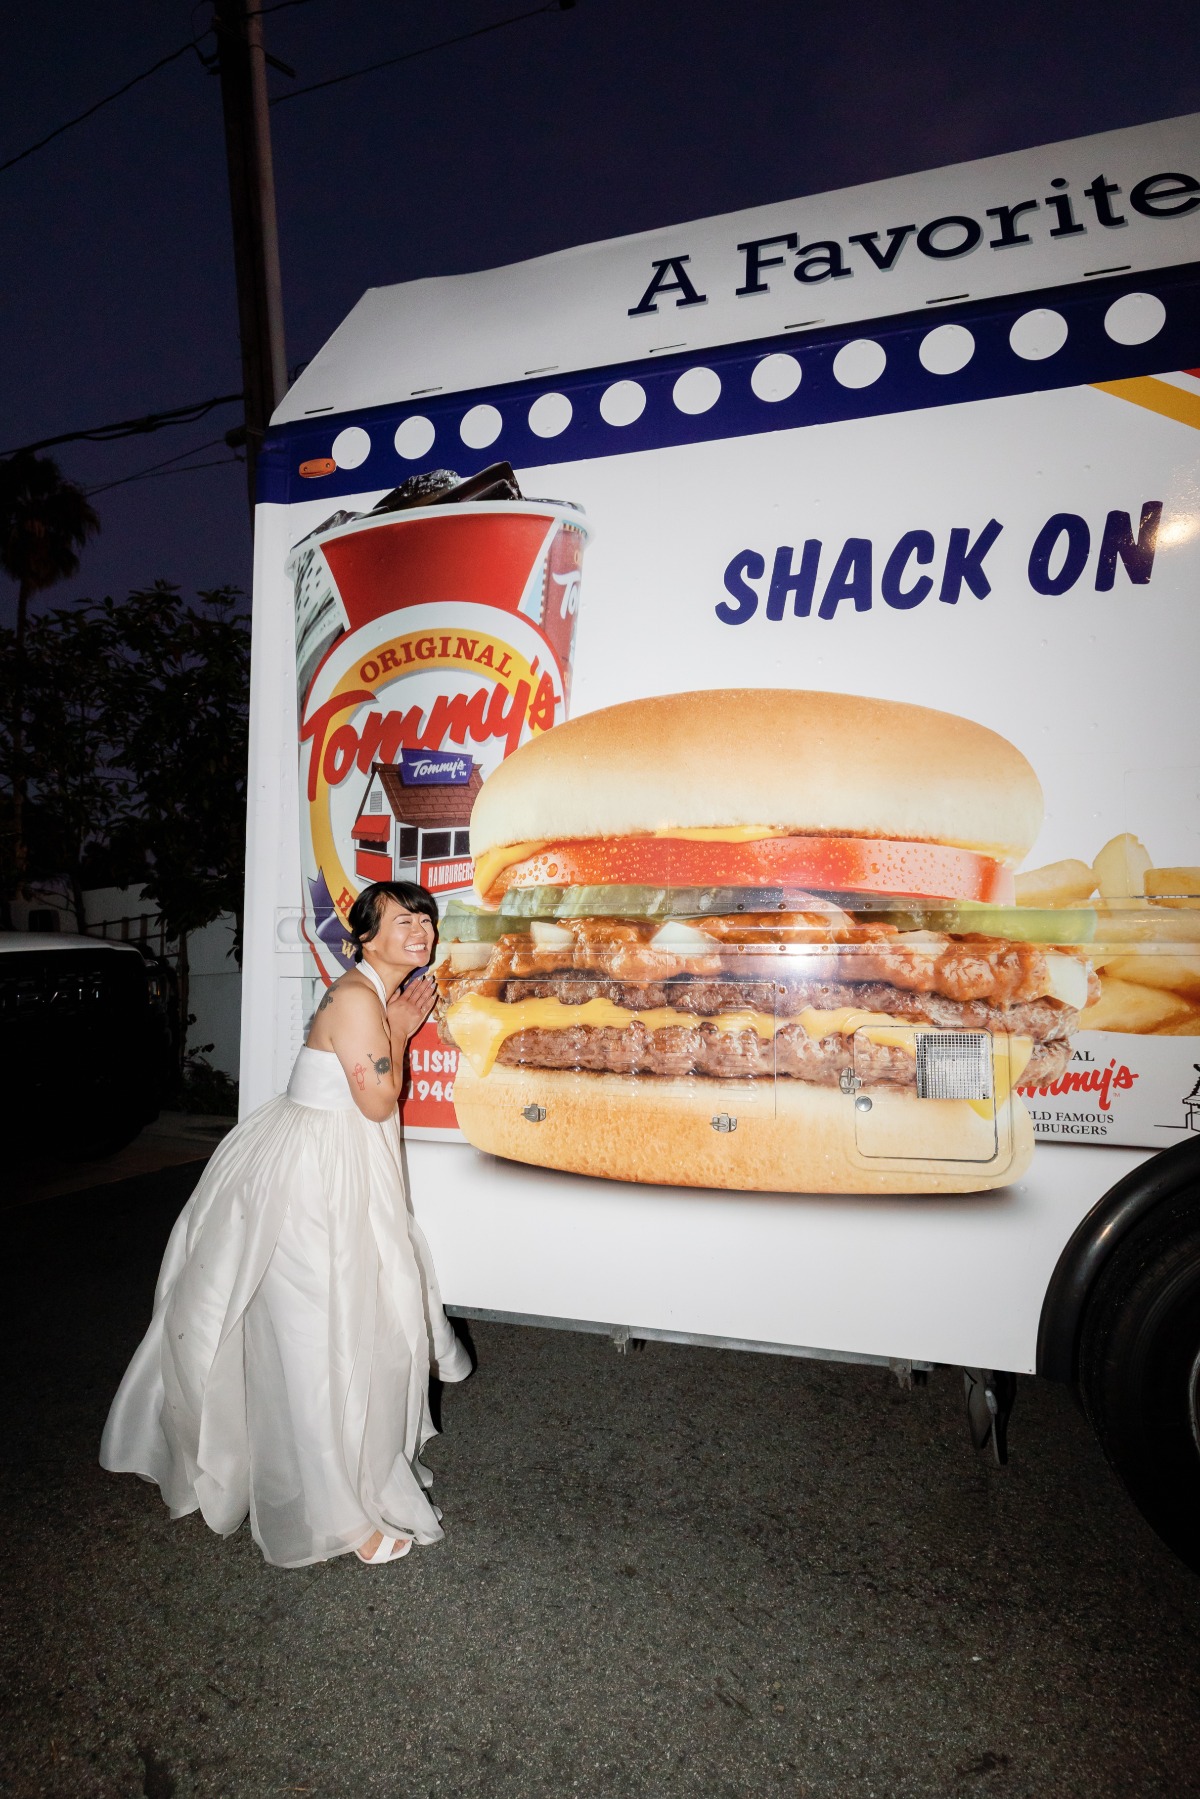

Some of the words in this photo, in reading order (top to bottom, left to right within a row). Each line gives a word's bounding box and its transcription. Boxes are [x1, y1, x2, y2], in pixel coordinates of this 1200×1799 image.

[628, 254, 707, 317] A
[735, 172, 1200, 297] Favorite
[715, 518, 1003, 626] SHACK
[1027, 501, 1163, 597] ON
[359, 636, 513, 684] ORIGINAL
[300, 655, 562, 802] Tommy's
[408, 757, 466, 779] Tommy's
[428, 861, 474, 887] HAMBURGERS
[408, 1079, 454, 1102] 1946
[1033, 1123, 1108, 1136] MBURGERS
[1055, 1111, 1114, 1124] FAMOUS
